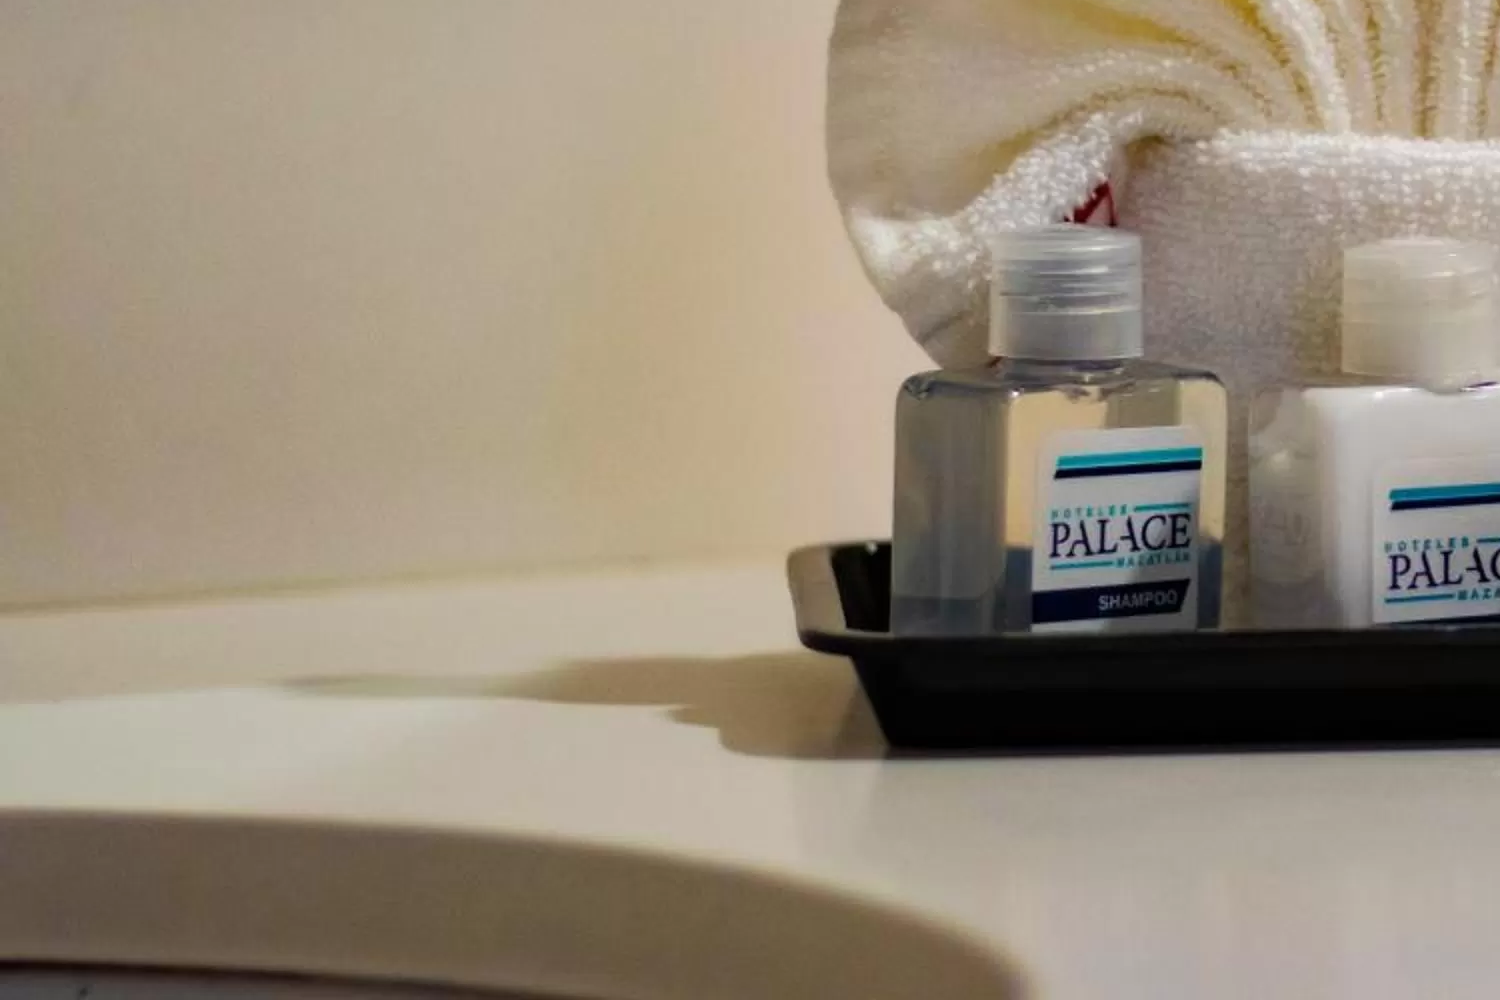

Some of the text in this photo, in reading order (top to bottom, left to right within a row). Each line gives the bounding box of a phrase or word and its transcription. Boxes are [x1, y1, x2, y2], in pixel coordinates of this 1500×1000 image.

[1049, 512, 1192, 558] PALACE
[1384, 535, 1470, 553] HOTELES
[1098, 589, 1178, 611] SHAMPOO
